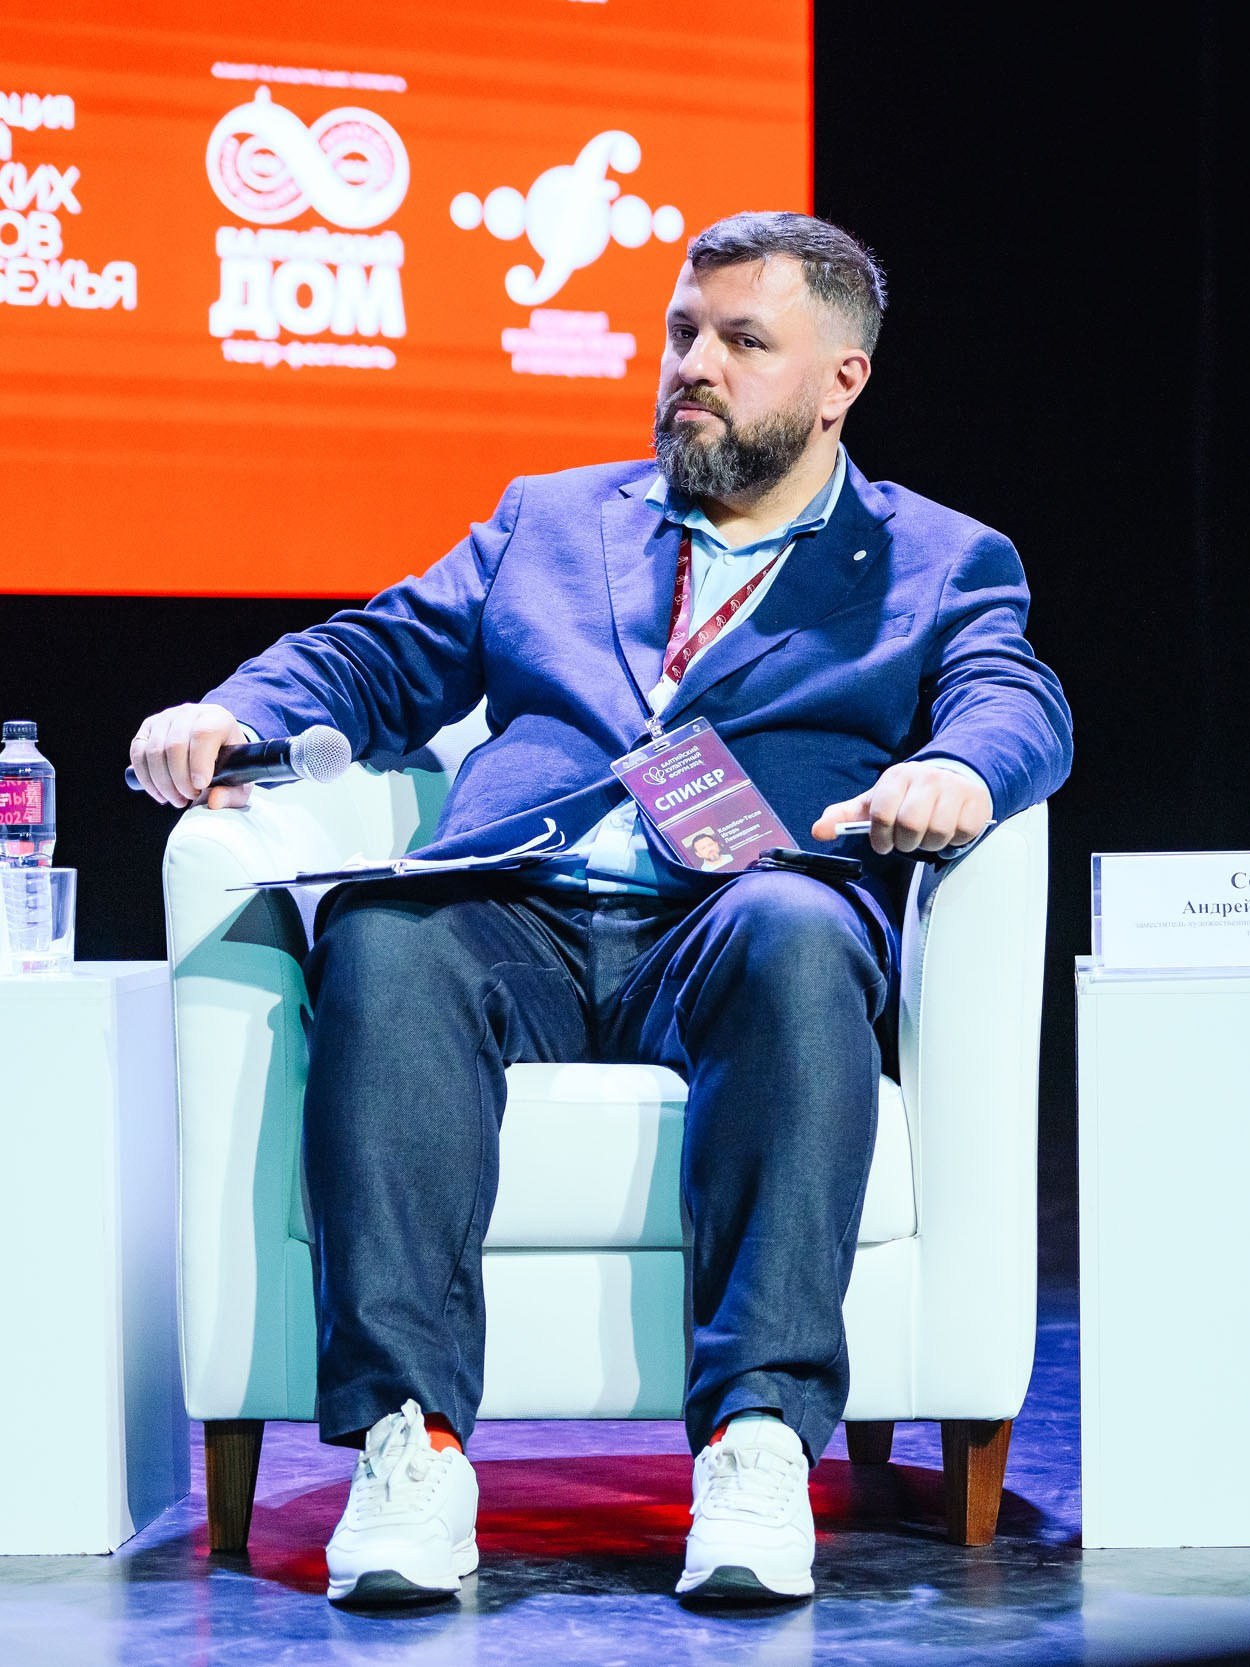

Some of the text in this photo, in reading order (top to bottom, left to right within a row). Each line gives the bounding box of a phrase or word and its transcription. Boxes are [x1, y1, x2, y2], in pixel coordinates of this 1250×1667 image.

[0, 258, 137, 311] ЕЖЬЯ
[209, 257, 407, 340] ДОМ
[660, 745, 700, 768] БАЛТИЙСКИЙ
[664, 752, 702, 774] КУЛЬТУРНЫЙ
[668, 764, 691, 779] ФОРУМ
[654, 768, 726, 811] СПИКЕР
